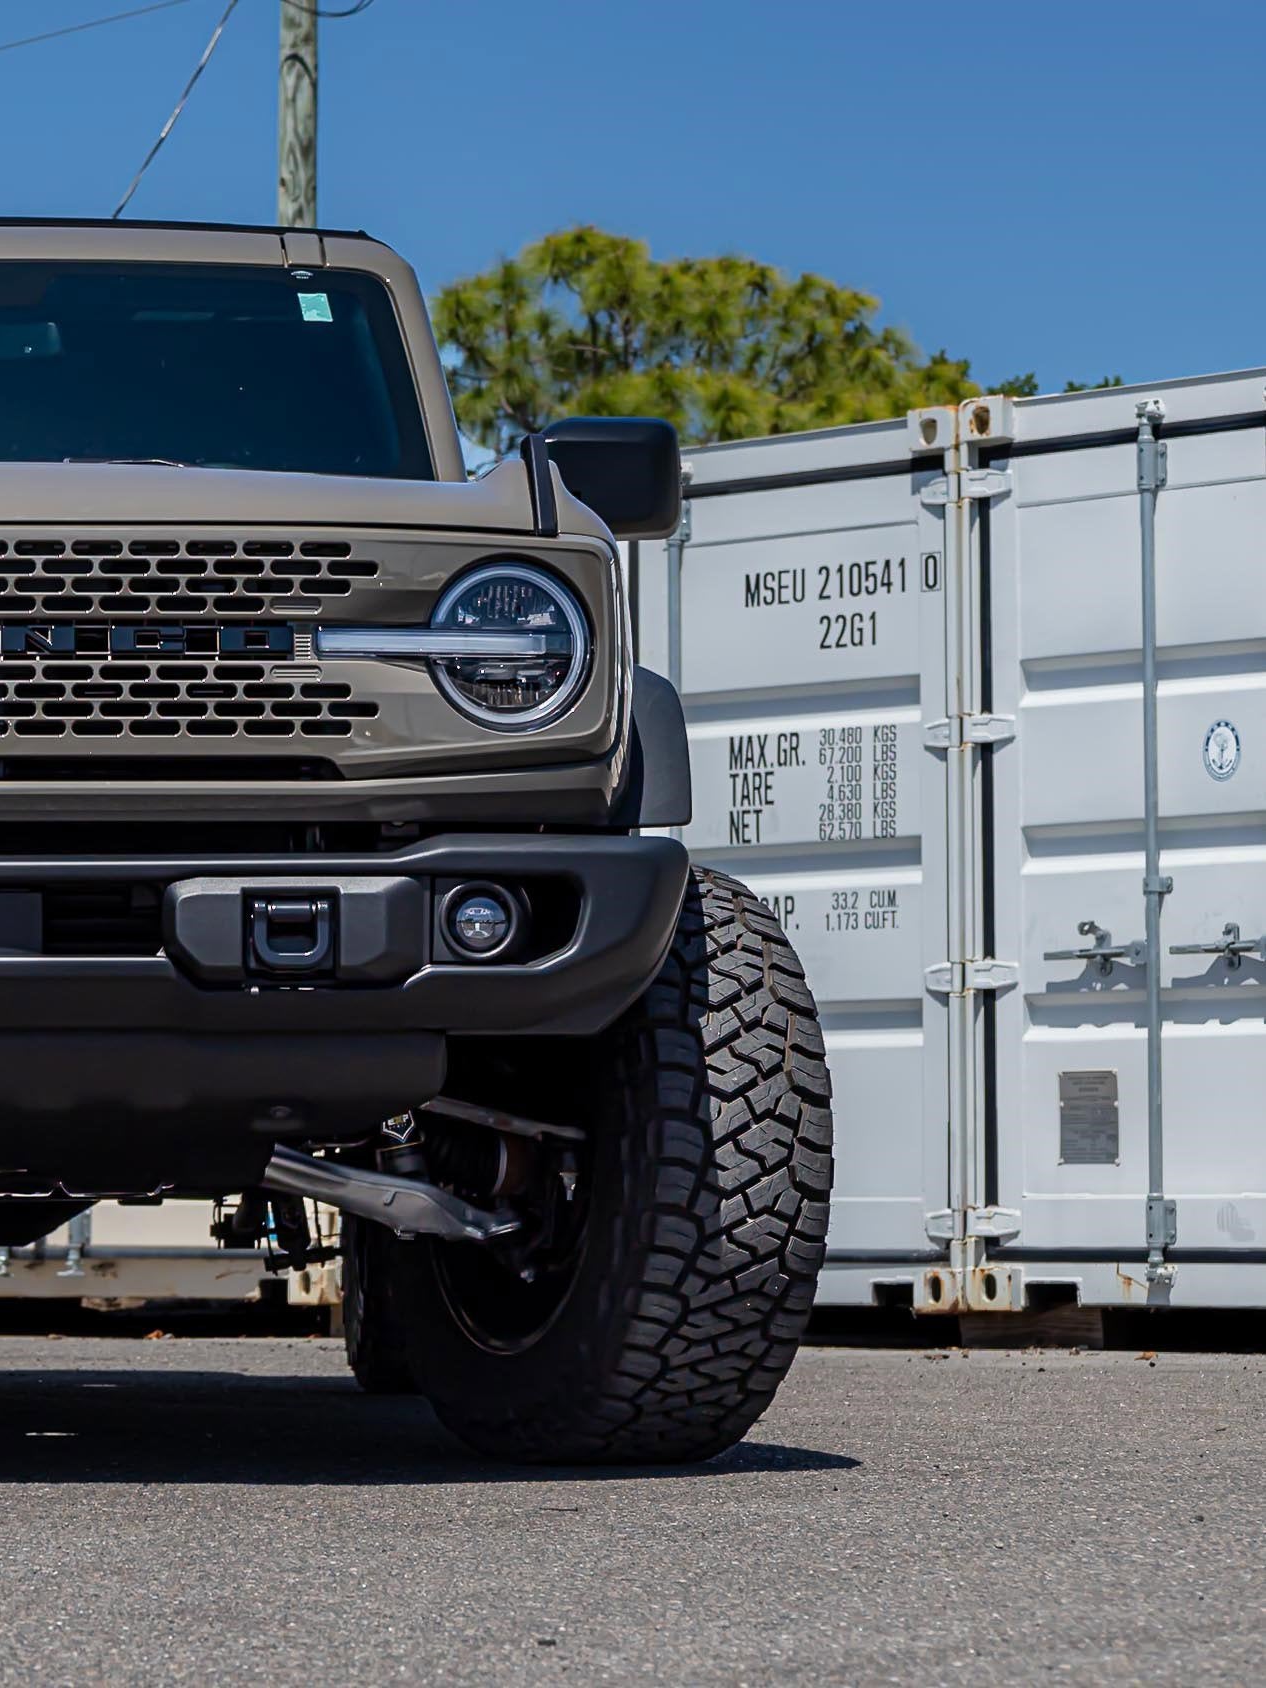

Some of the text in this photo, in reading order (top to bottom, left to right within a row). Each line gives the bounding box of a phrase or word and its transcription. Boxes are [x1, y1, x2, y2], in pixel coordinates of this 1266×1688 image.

[745, 554, 938, 608] MSEU 210541 0
[819, 611, 876, 649] 22G1
[729, 725, 897, 771] MAX.GR. 30.480 KGS
[819, 744, 897, 765] 67.200 LBS
[729, 763, 897, 807] TARE 2.100 KGS
[827, 782, 897, 802] 4.630 LBS
[729, 801, 897, 844] NET 28.380 KGS
[819, 820, 897, 840] 62.570 LBS
[832, 891, 859, 910] 33.2
[825, 912, 859, 931] 1.173
